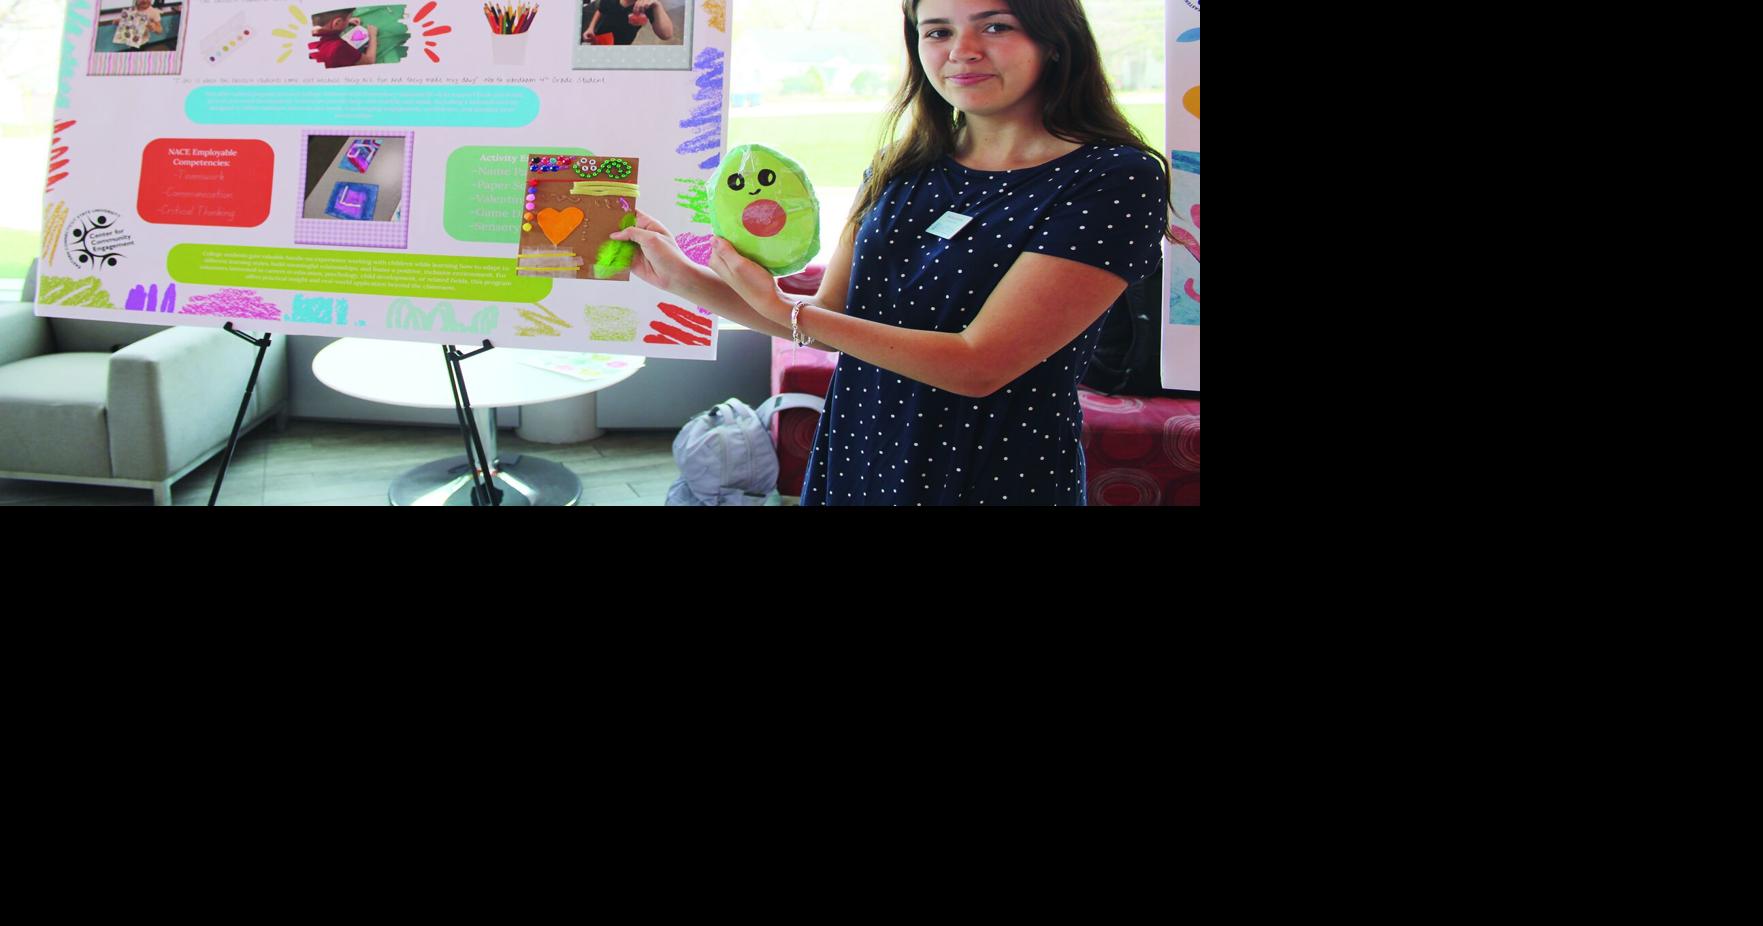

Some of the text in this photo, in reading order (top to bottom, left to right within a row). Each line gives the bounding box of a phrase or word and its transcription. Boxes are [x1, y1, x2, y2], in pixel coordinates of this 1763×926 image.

[168, 148, 238, 158] NACE Employable
[480, 153, 516, 164] Activity
[172, 158, 231, 168] Competencies:
[472, 193, 524, 204] -Valentin
[89, 231, 112, 239] Center
[91, 235, 131, 246] Community
[92, 241, 134, 252] Engagement
